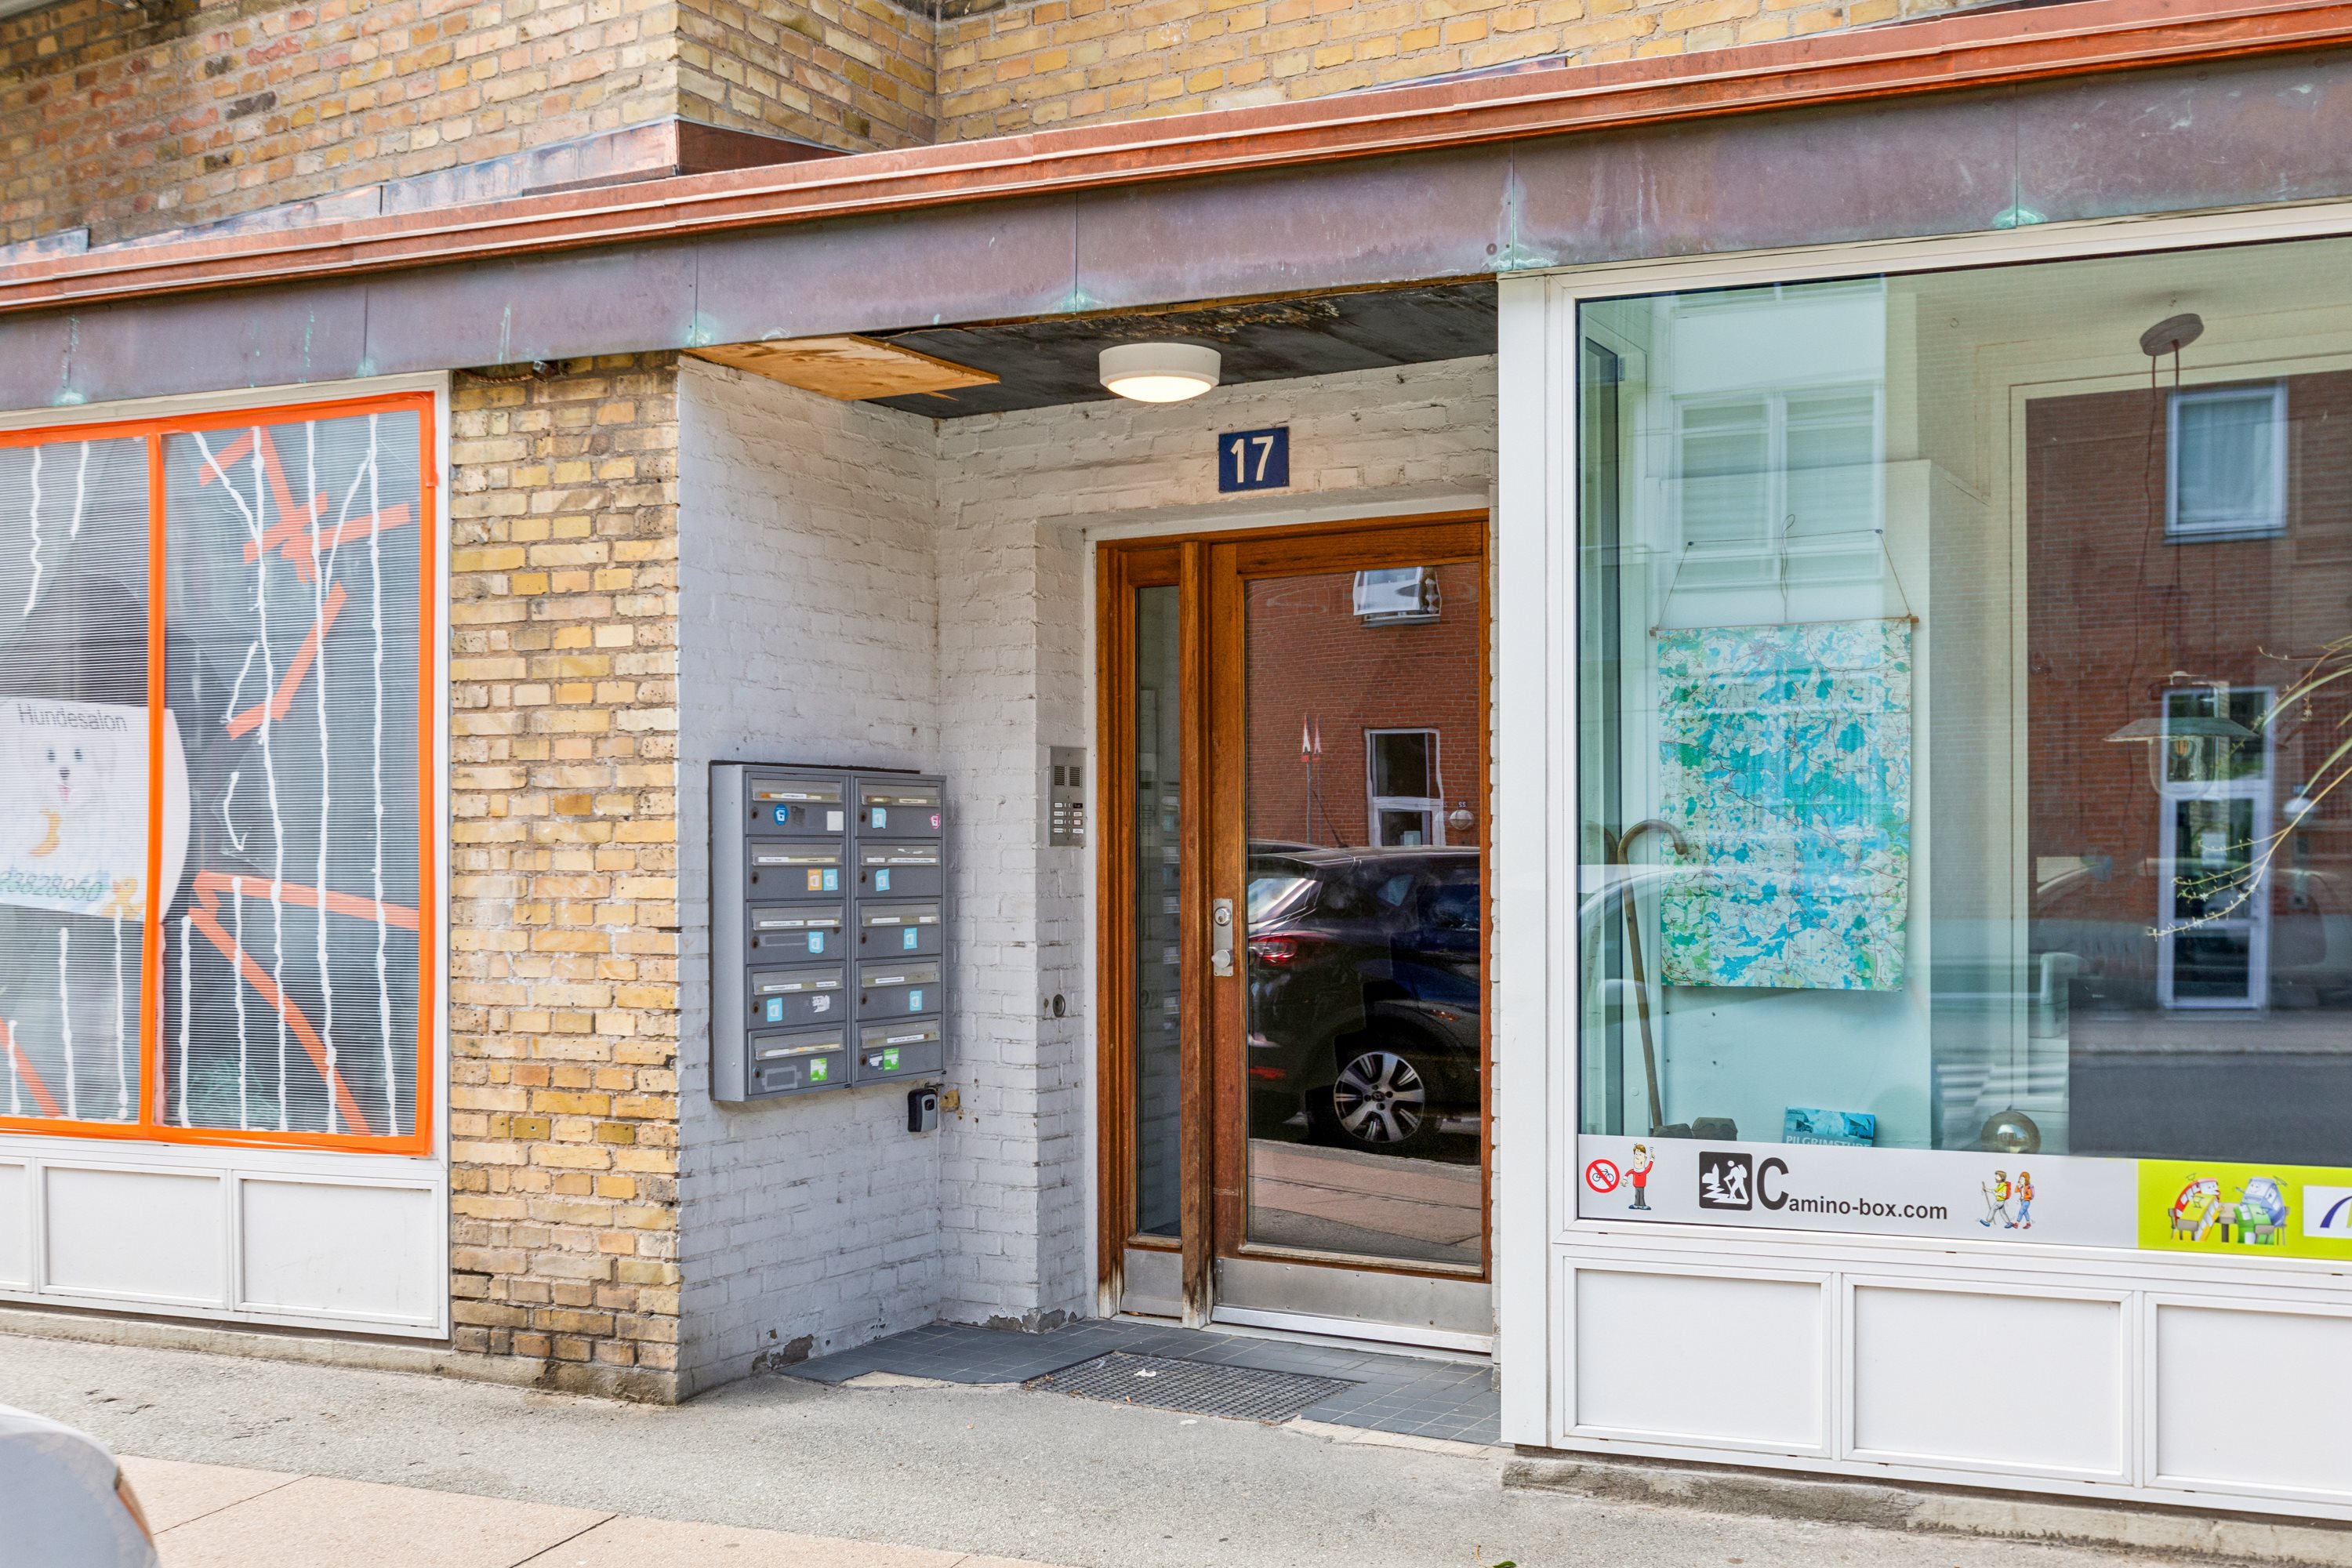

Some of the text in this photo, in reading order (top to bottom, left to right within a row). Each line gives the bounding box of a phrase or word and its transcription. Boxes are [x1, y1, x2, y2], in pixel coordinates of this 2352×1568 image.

[1230, 435, 1274, 484] 17
[17, 703, 129, 731] Hundesalon
[1756, 1156, 1947, 1219] Camino-box.com
